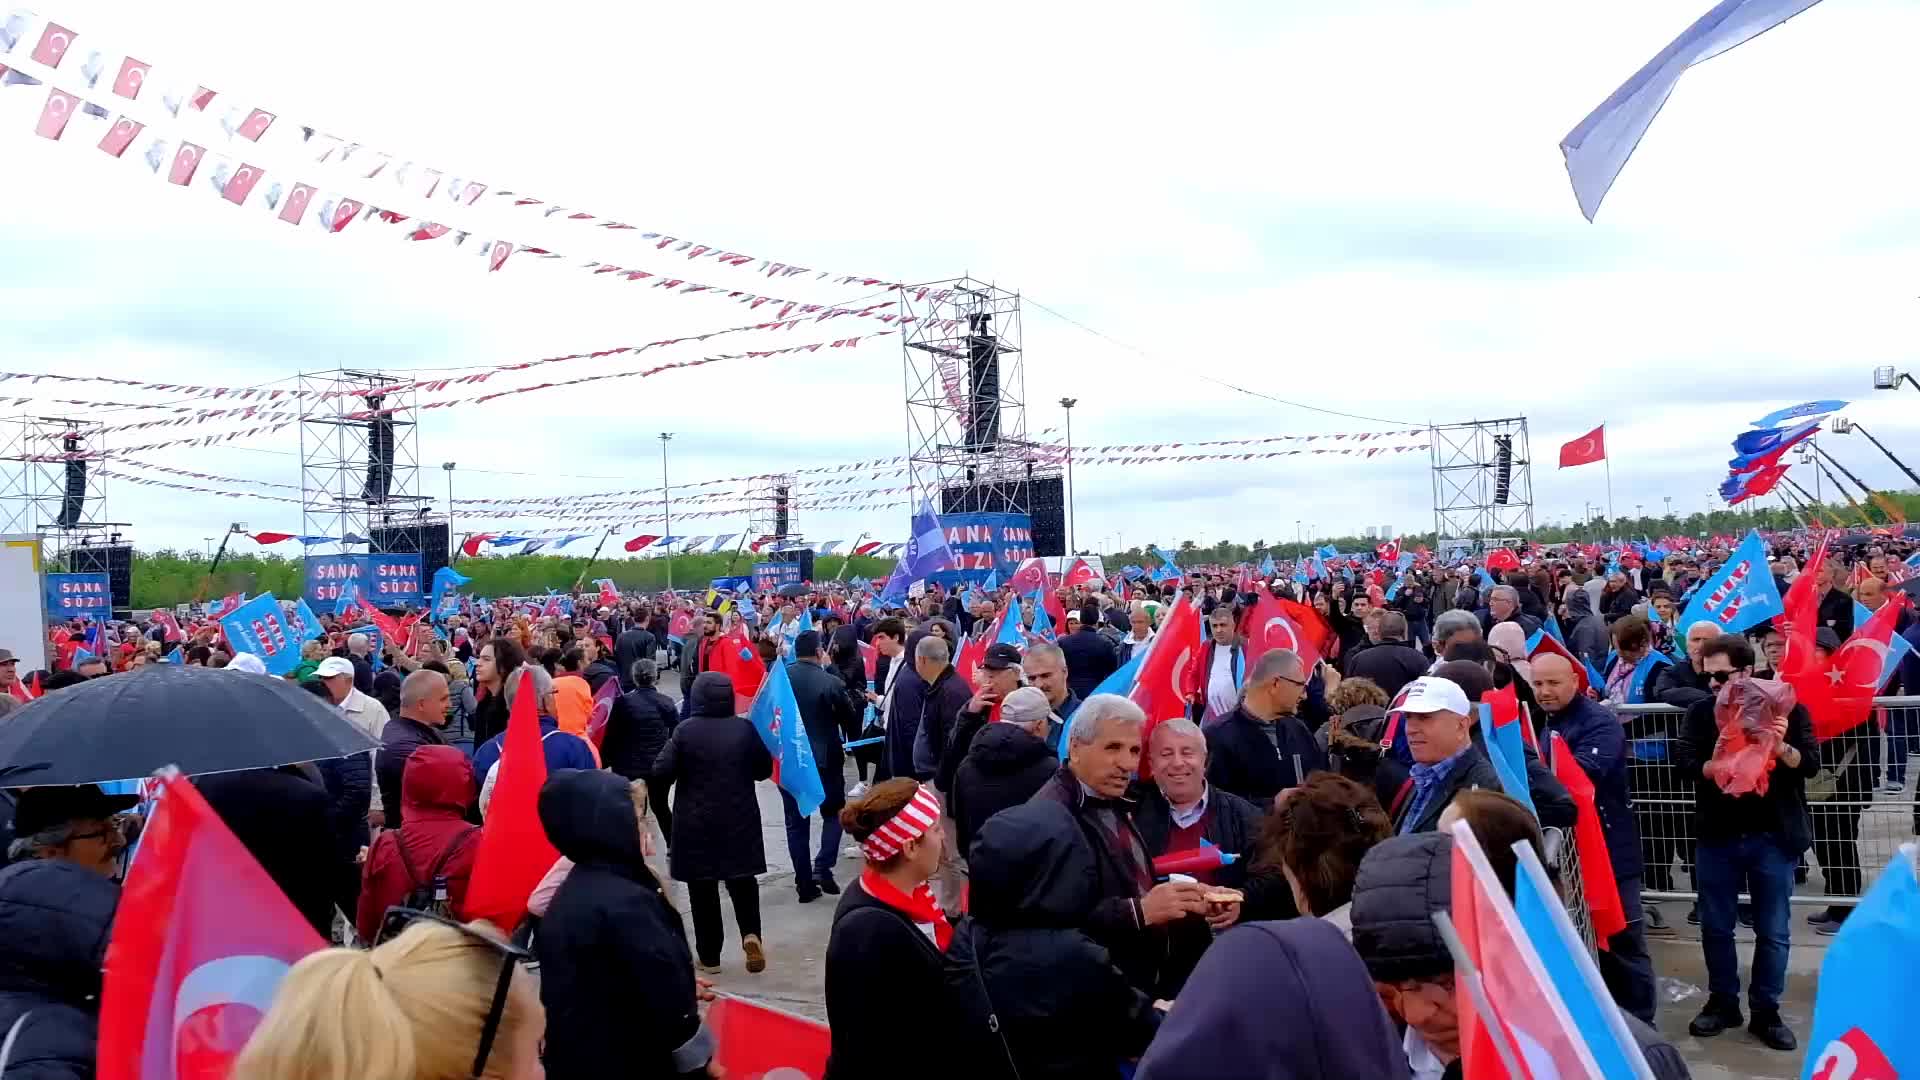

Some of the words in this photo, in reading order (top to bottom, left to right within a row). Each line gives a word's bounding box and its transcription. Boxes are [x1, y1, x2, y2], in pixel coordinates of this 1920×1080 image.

[949, 525, 992, 544] ANA
[1003, 527, 1031, 542] SANA
[317, 563, 359, 579] SANA
[379, 564, 417, 576] SANA
[62, 583, 102, 593] SANA
